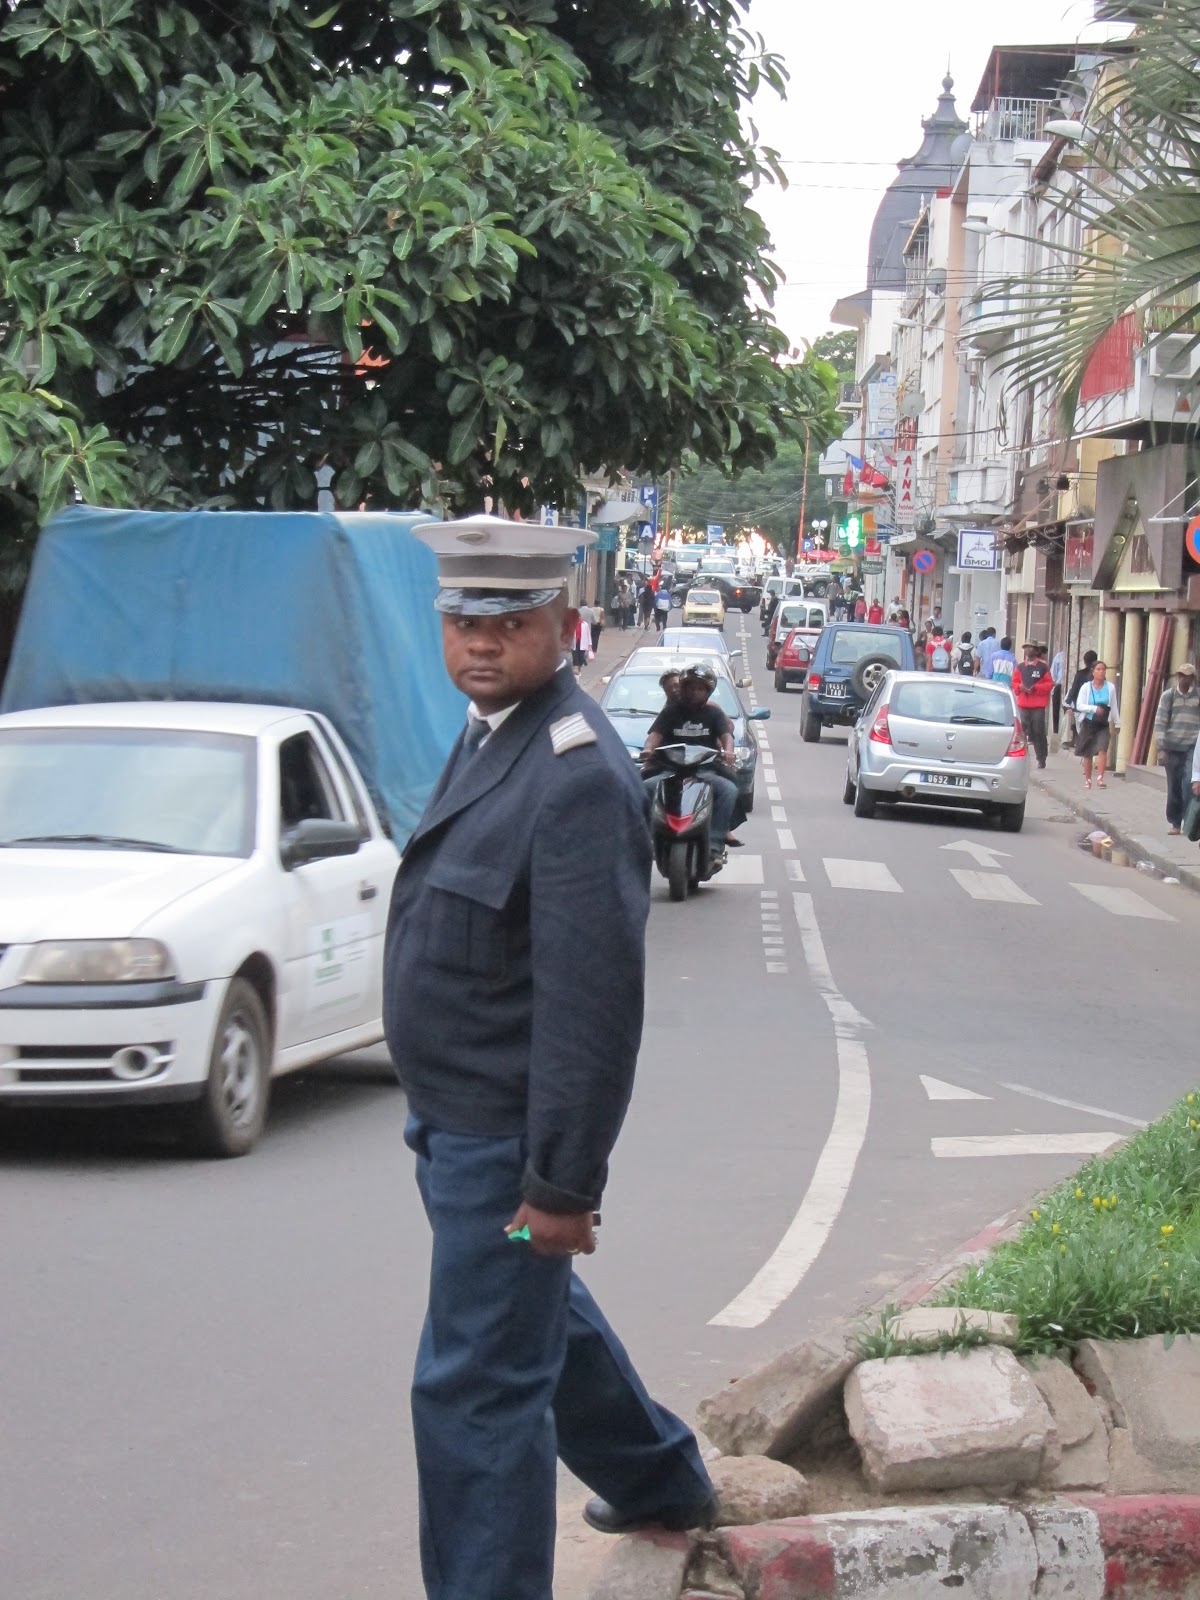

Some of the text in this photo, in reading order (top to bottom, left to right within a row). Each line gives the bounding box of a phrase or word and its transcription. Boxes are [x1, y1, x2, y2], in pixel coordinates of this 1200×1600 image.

[902, 455, 912, 502] AINA
[804, 541, 811, 550] P
[928, 774, 968, 787] 0692 TAP
